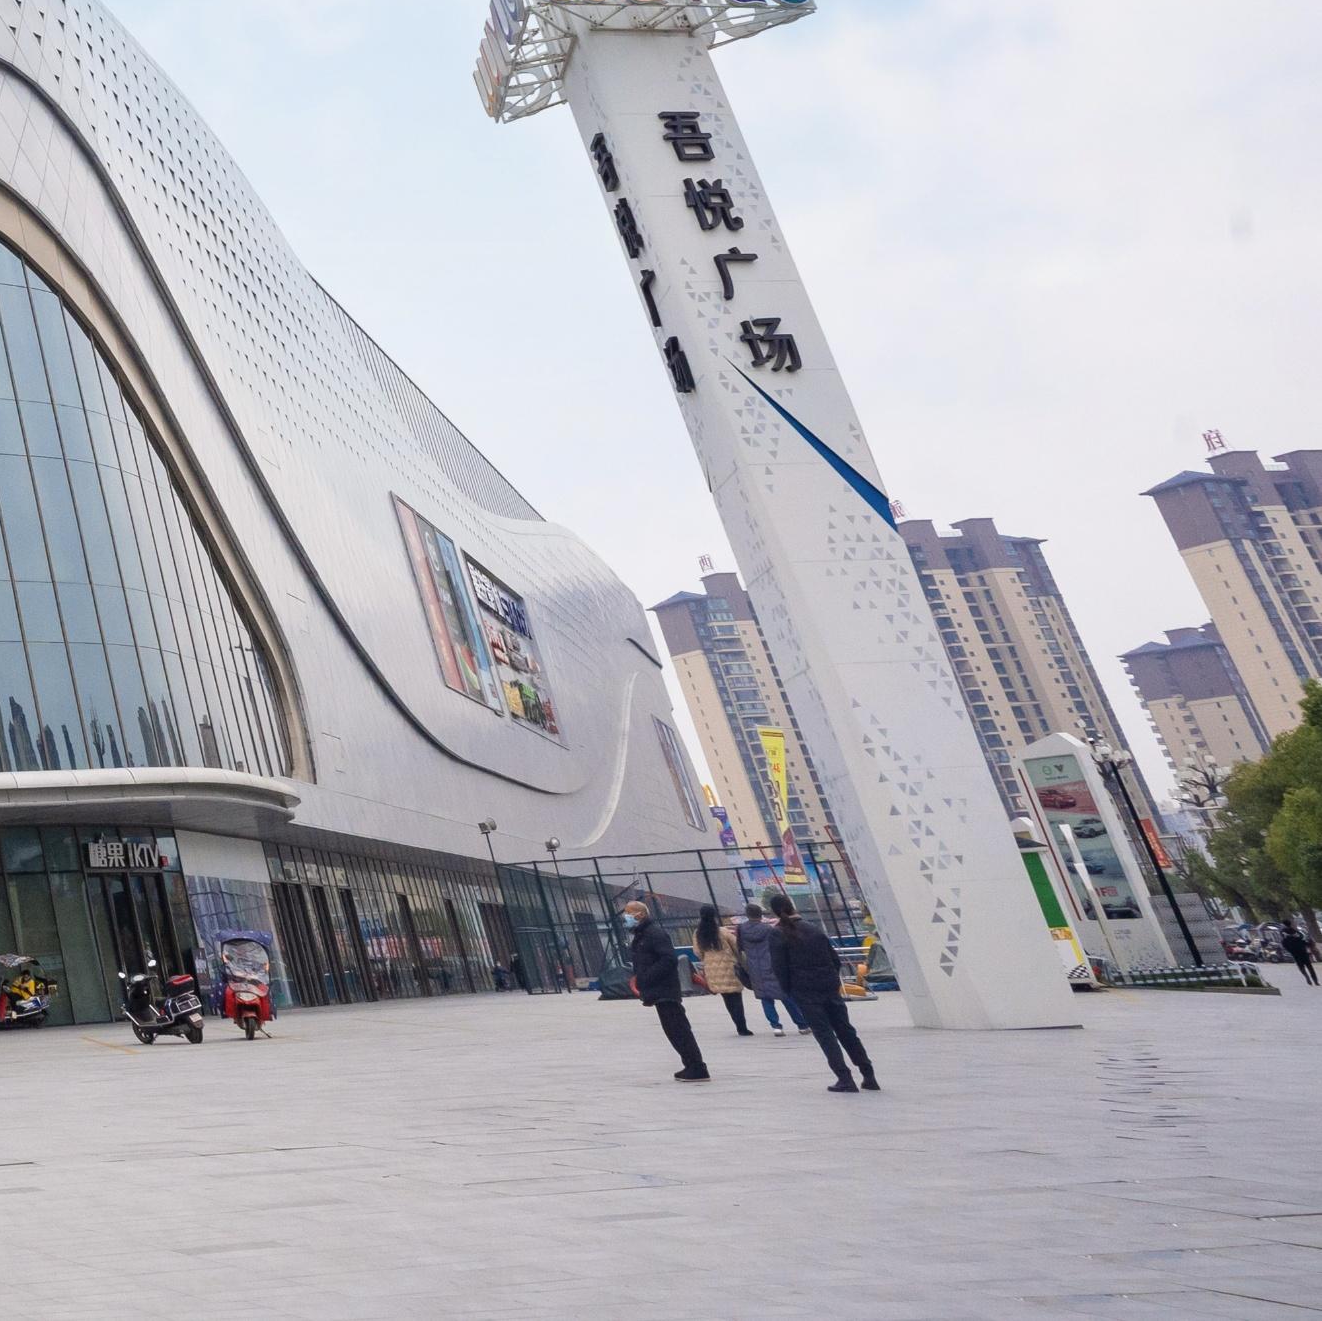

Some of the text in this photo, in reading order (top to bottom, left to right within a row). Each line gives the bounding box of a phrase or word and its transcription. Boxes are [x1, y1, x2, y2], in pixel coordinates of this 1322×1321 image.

[658, 111, 803, 373] 吾悦广场
[88, 841, 126, 868] 糖果
